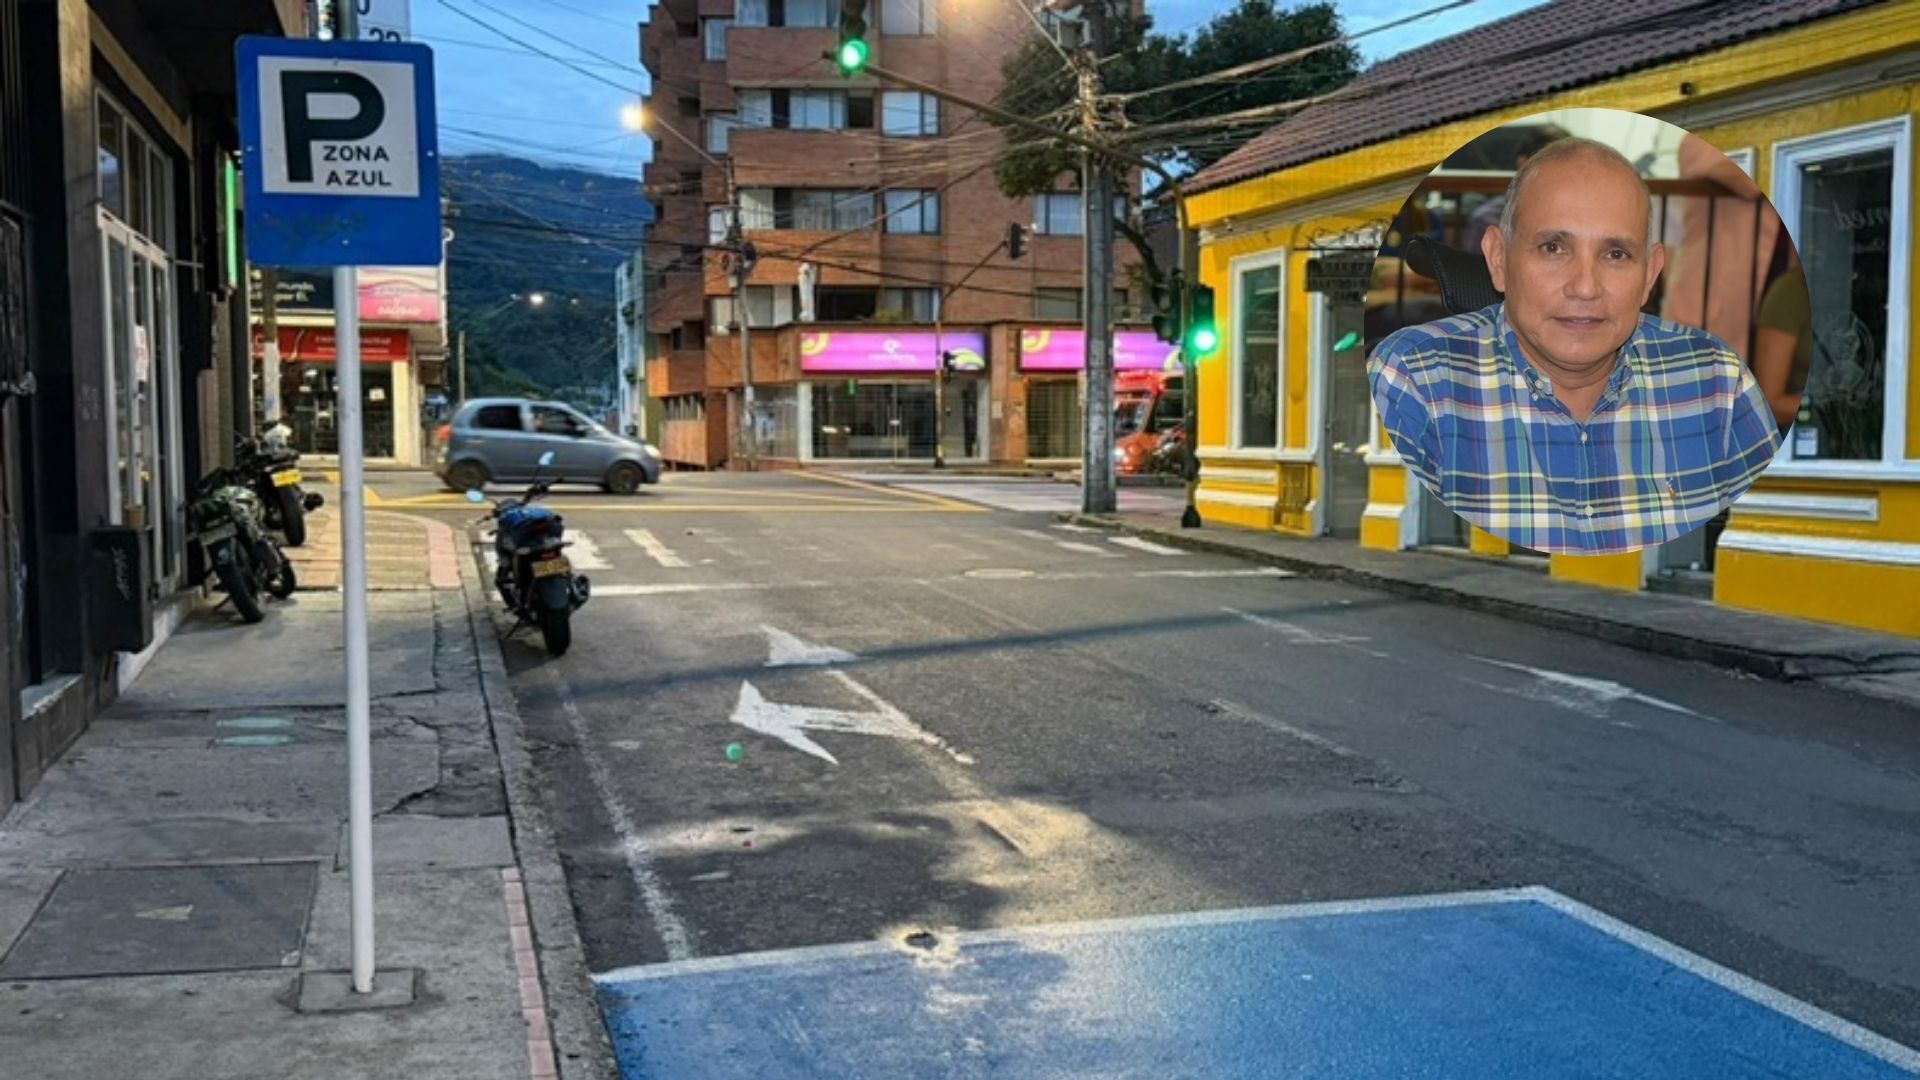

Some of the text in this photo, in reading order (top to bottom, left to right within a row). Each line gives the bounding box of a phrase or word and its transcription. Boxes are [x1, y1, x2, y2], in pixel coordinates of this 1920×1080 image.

[280, 70, 385, 183] P
[323, 145, 389, 162] ZONA
[326, 170, 392, 187] AZUL
